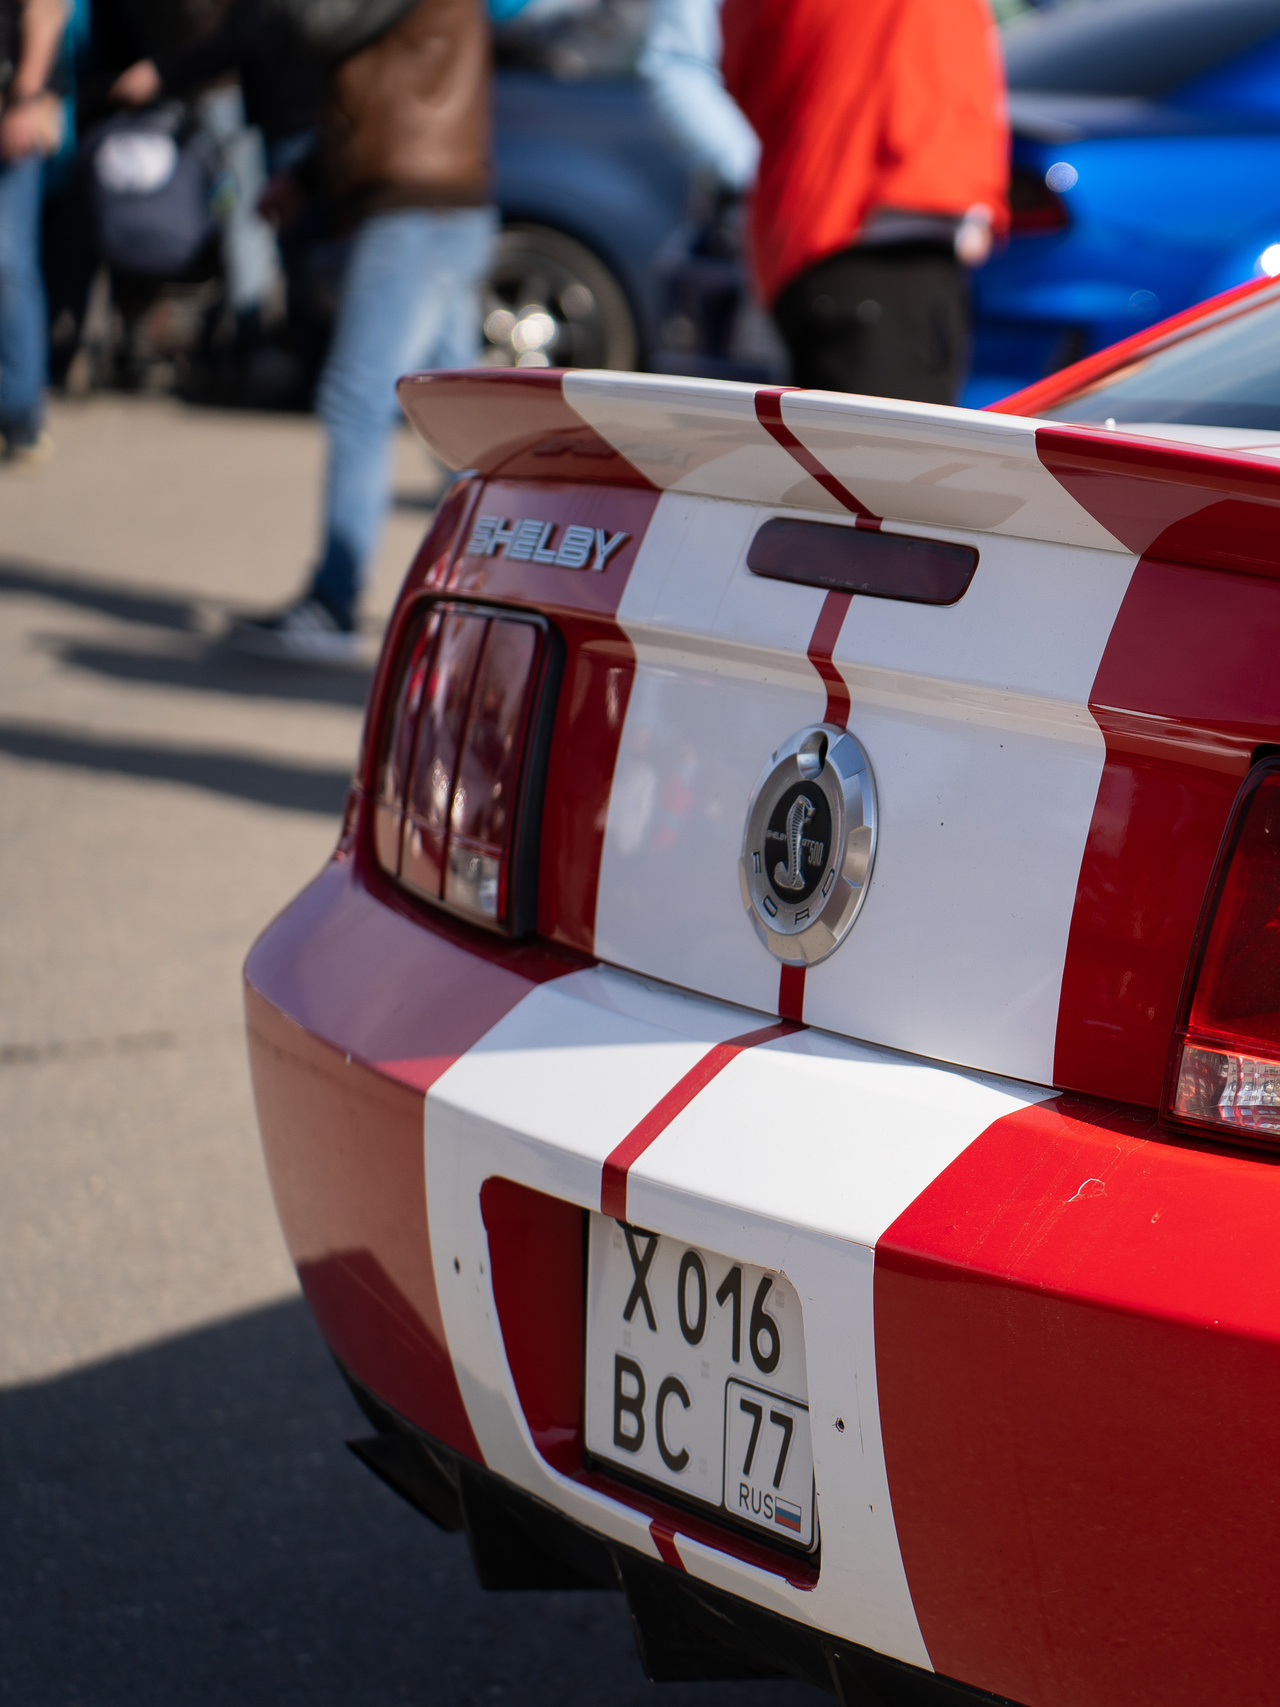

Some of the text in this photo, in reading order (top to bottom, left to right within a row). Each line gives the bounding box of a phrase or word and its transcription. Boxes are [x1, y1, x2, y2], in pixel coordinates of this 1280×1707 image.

[466, 515, 630, 571] SHELBY
[614, 1353, 688, 1472] BC
[740, 1398, 794, 1489] 77
[738, 1482, 774, 1520] RUS
